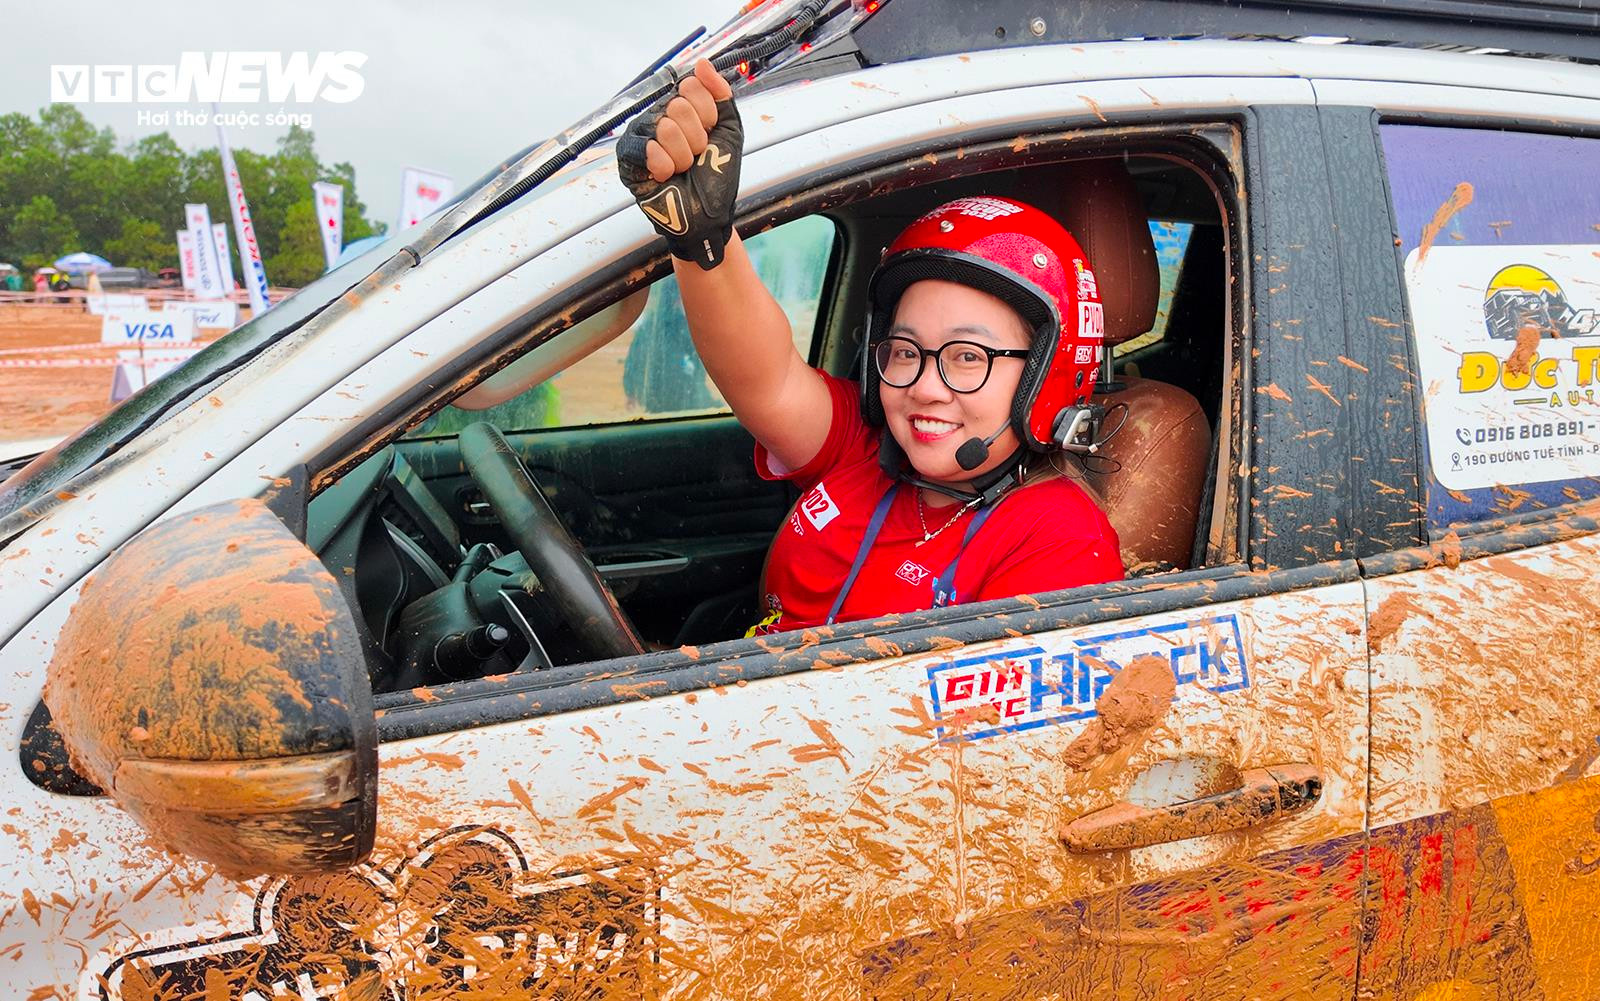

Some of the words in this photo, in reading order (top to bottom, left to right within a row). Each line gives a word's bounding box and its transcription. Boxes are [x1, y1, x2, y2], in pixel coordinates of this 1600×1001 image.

[124, 324, 174, 339] VISA
[1550, 390, 1600, 407] AUT
[1475, 428, 1515, 443] 0916
[1520, 423, 1553, 440] 808
[1557, 420, 1583, 436] 891
[1464, 454, 1486, 466] 190
